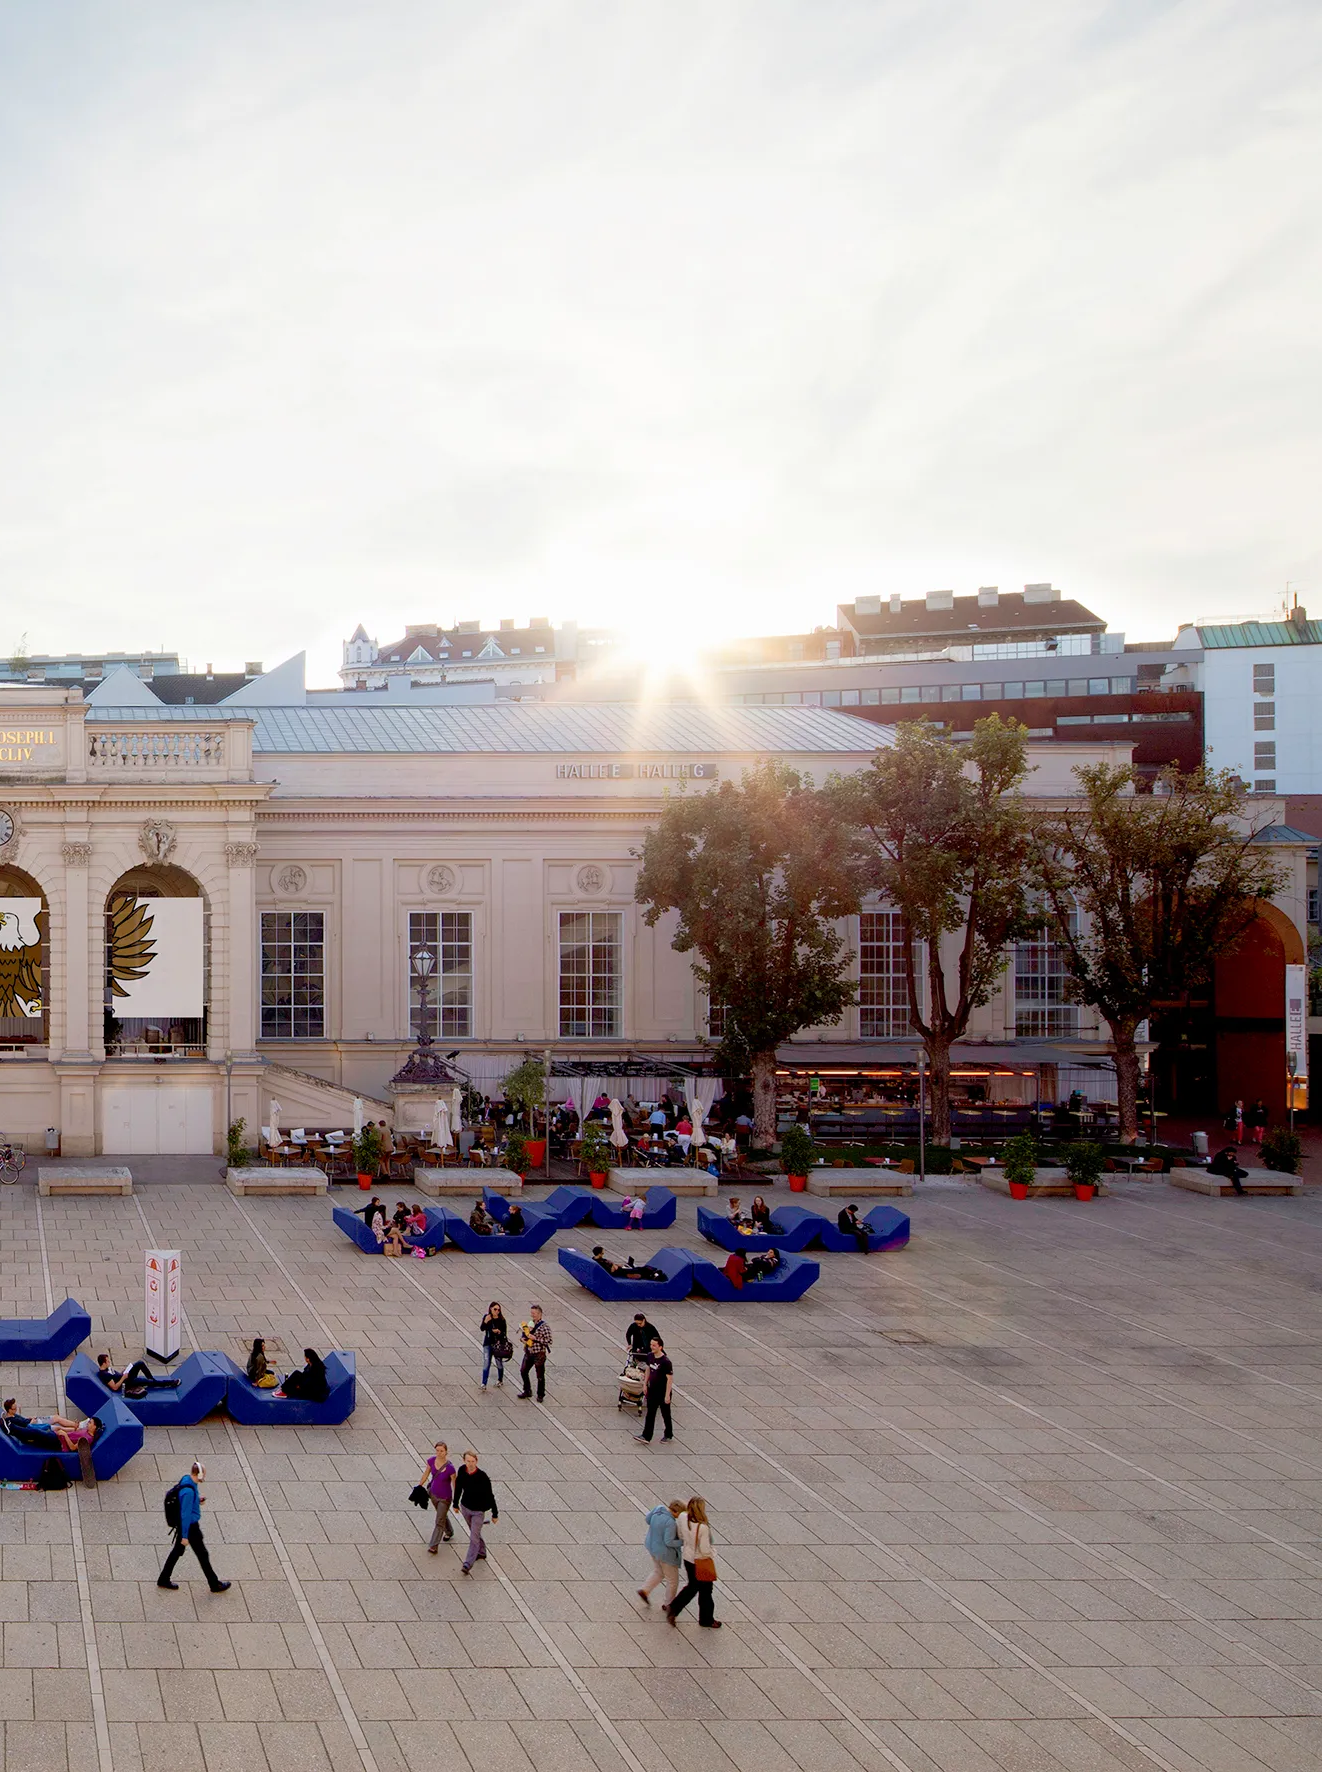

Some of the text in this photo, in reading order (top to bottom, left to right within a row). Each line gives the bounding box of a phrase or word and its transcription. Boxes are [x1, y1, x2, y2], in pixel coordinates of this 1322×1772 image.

[556, 763, 621, 778] HALLE E
[693, 763, 704, 778] G
[1289, 1016, 1302, 1050] HALLE
